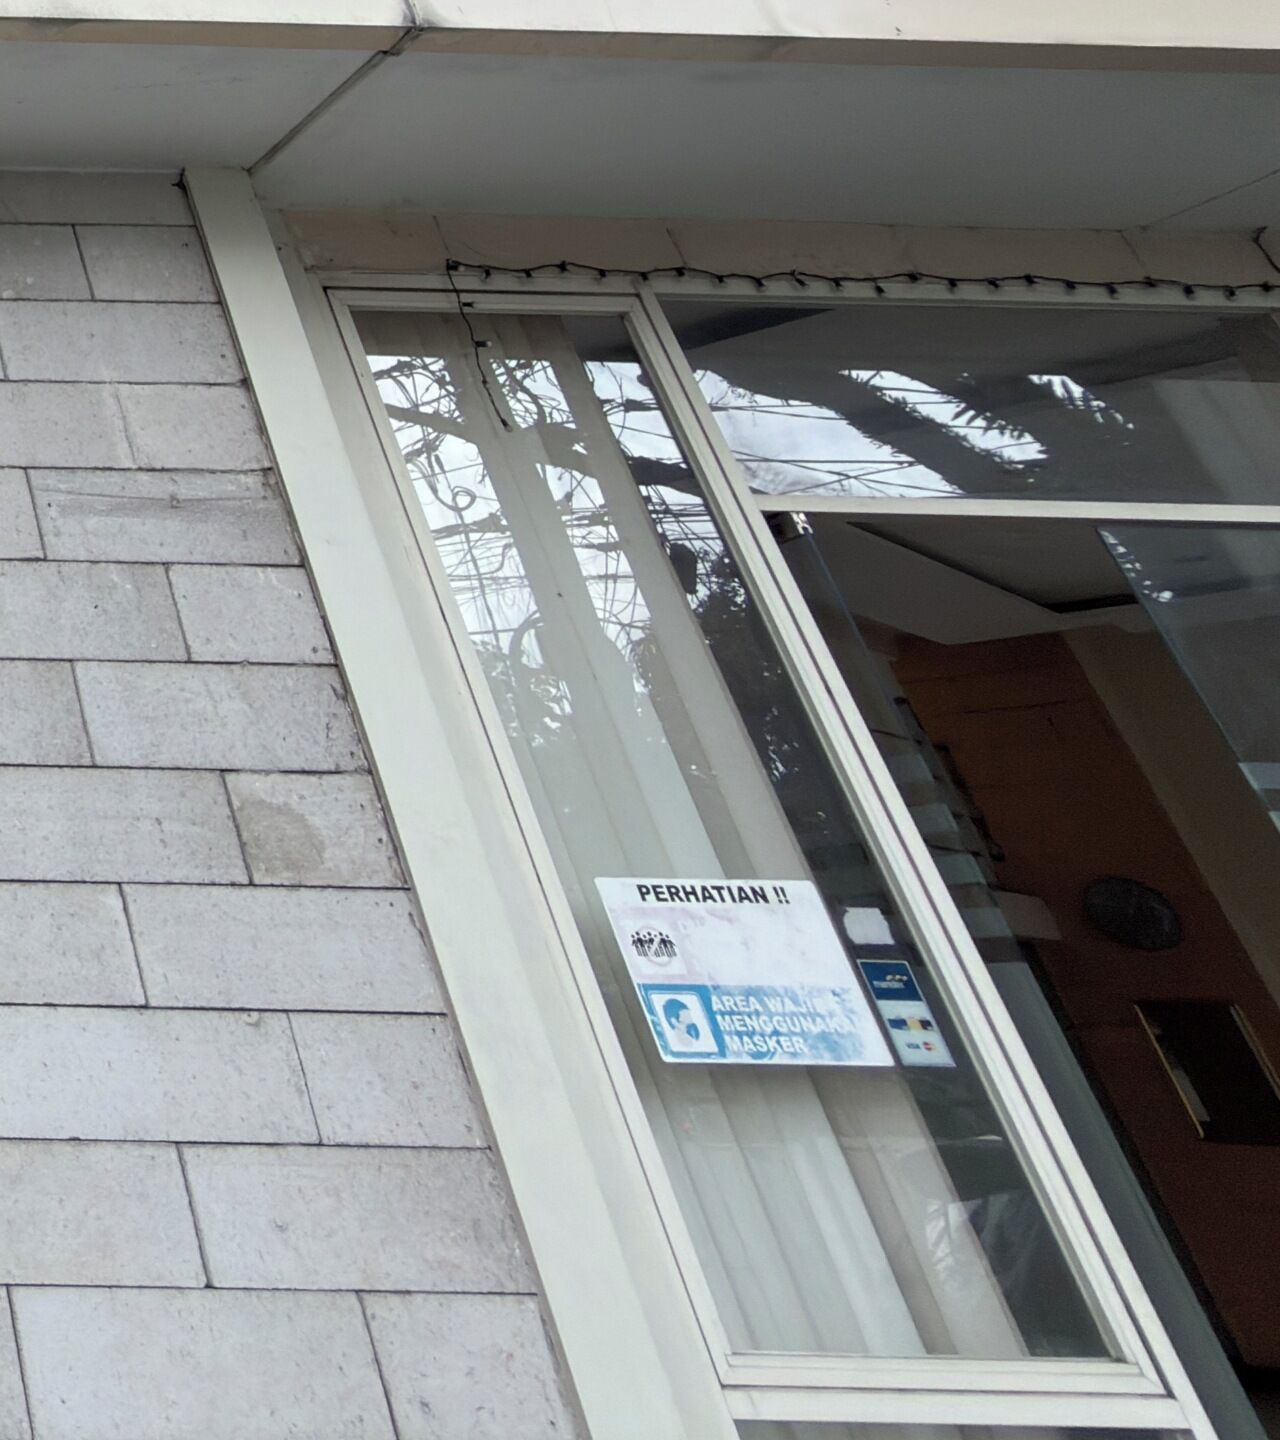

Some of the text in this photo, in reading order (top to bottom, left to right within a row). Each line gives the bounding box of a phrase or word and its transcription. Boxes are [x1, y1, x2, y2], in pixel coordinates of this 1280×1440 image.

[636, 883, 770, 905] PERHATIAN
[711, 995, 762, 1012] AREA
[724, 1034, 808, 1054] MASKER
